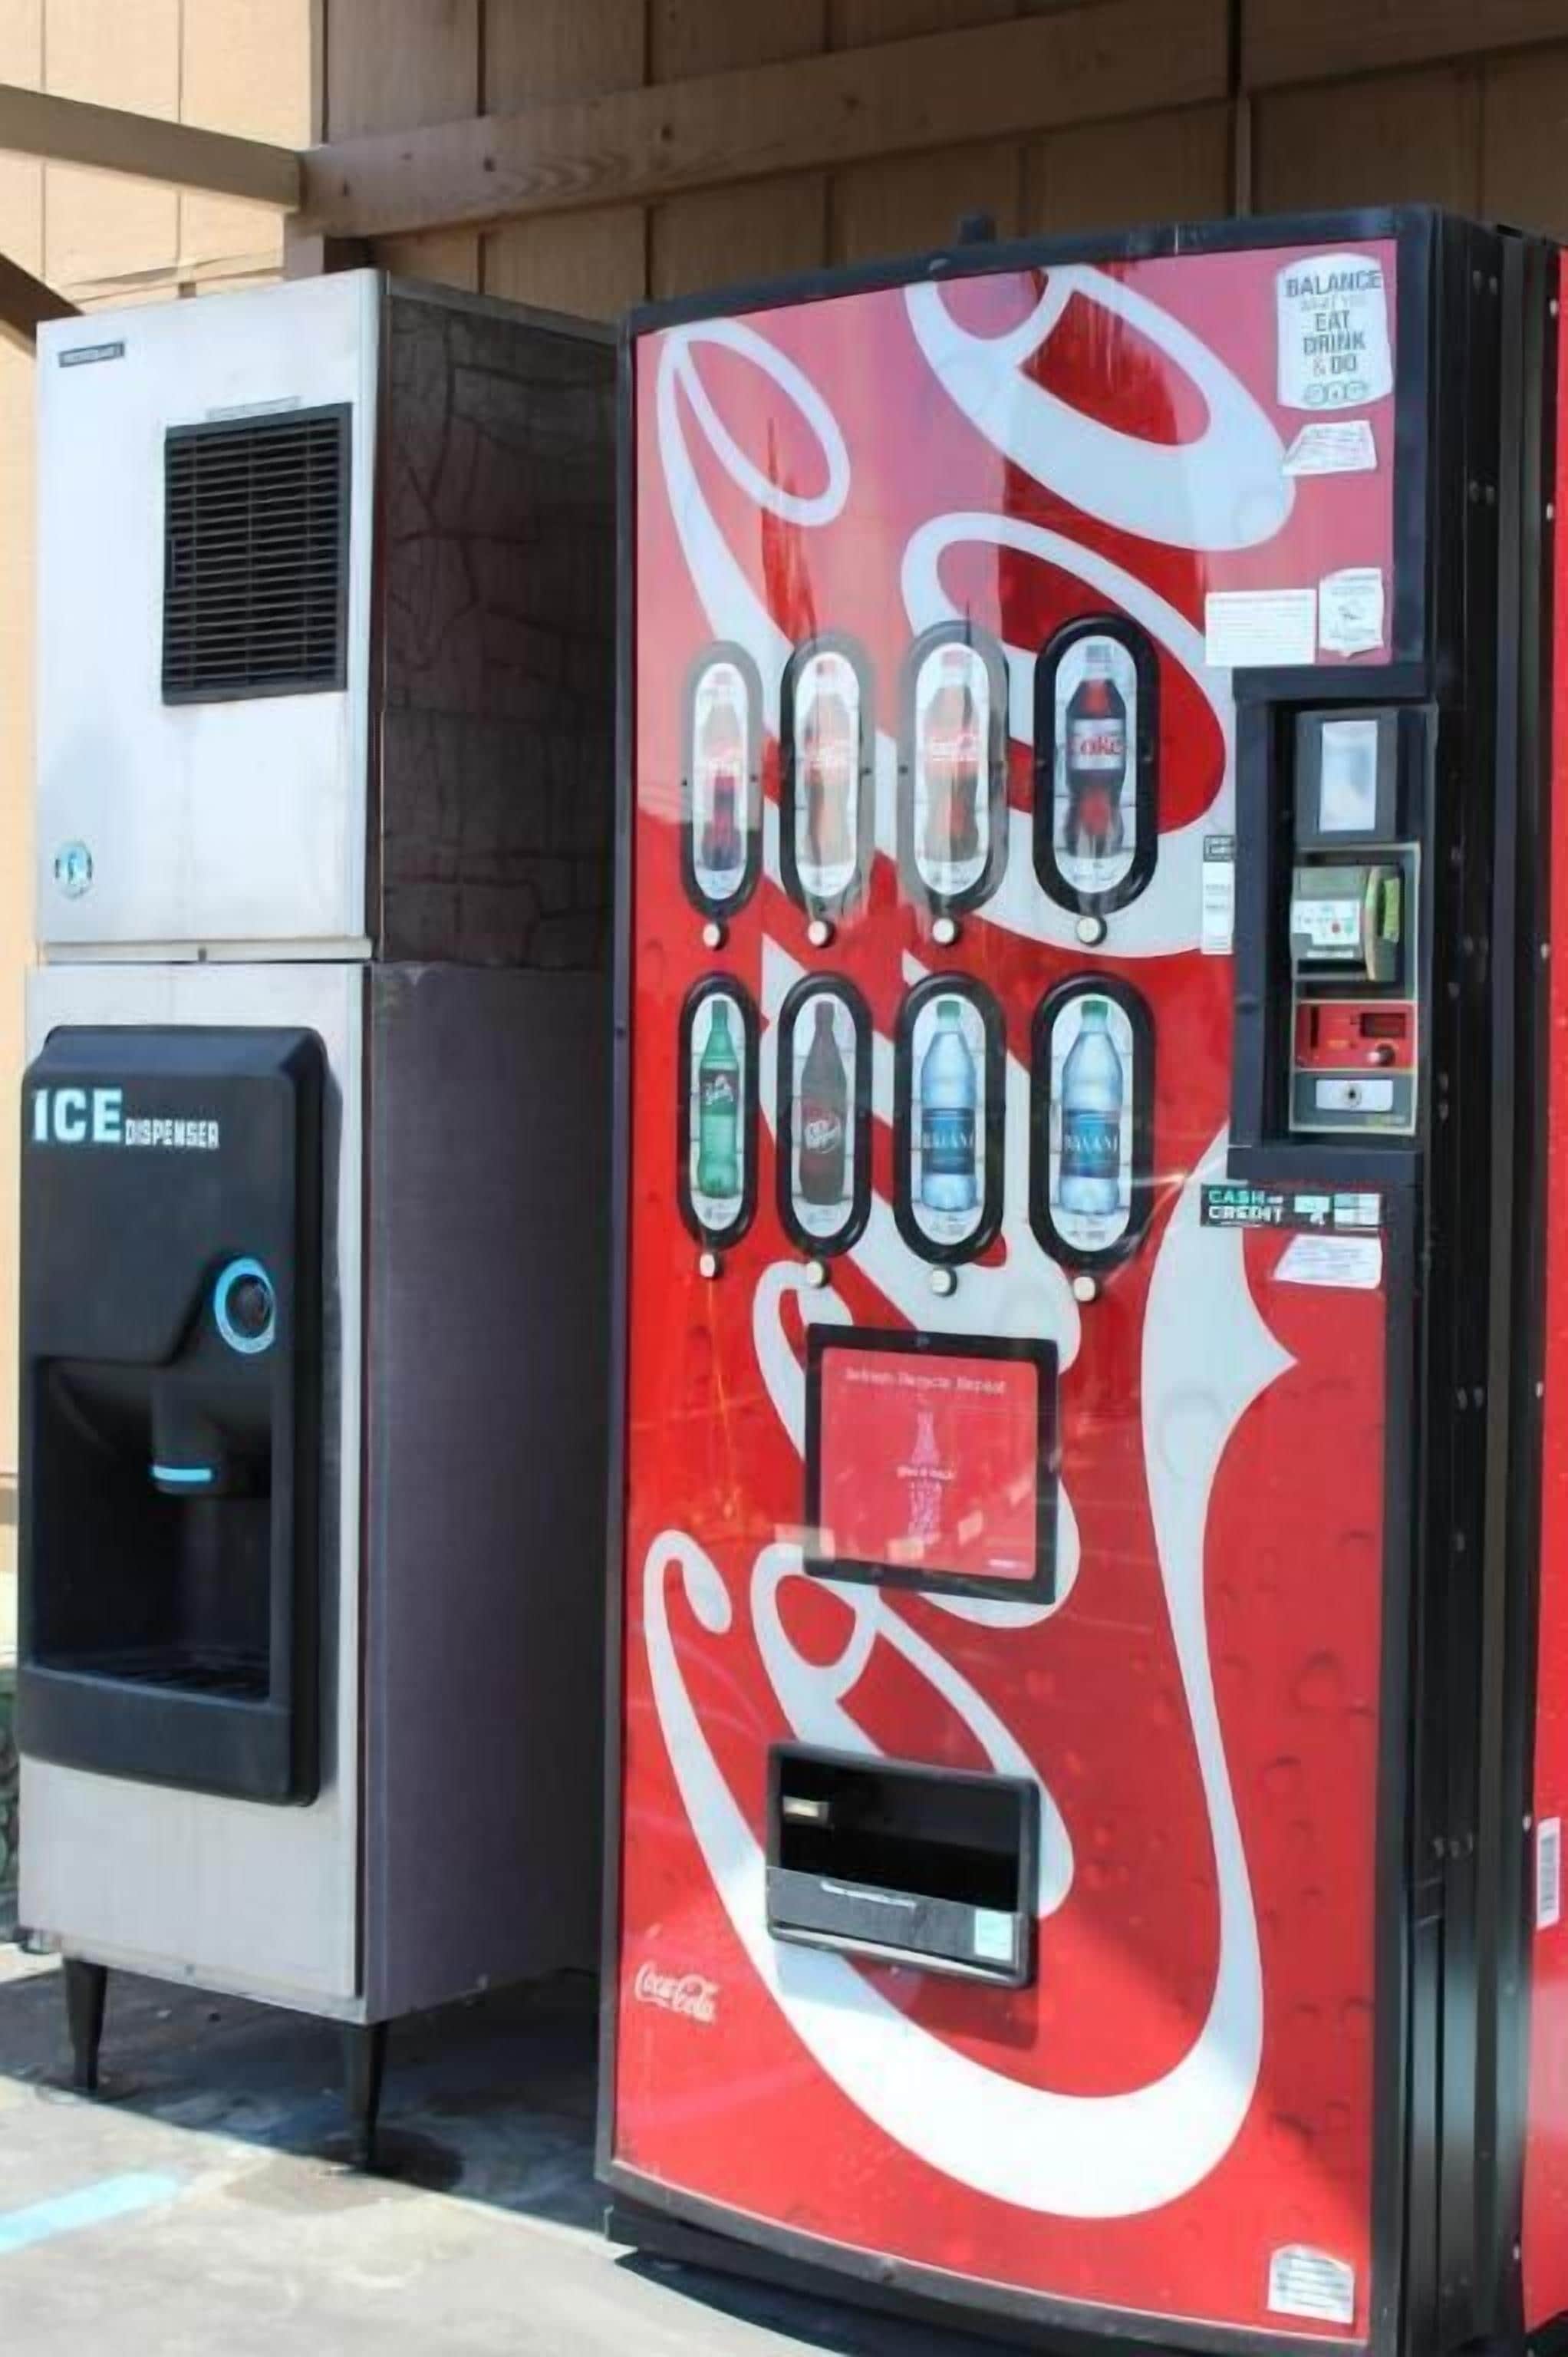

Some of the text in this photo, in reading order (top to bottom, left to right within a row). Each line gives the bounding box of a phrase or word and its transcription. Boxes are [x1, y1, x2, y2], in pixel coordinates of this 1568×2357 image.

[1285, 270, 1382, 298] BALANCE
[1314, 309, 1350, 332] EAT
[1303, 331, 1367, 356] DRINK
[1330, 353, 1357, 374] DO
[34, 1087, 220, 1149] ICE DISPENSER
[1208, 1189, 1266, 1205] CASH
[1208, 1205, 1284, 1224] CREDIT
